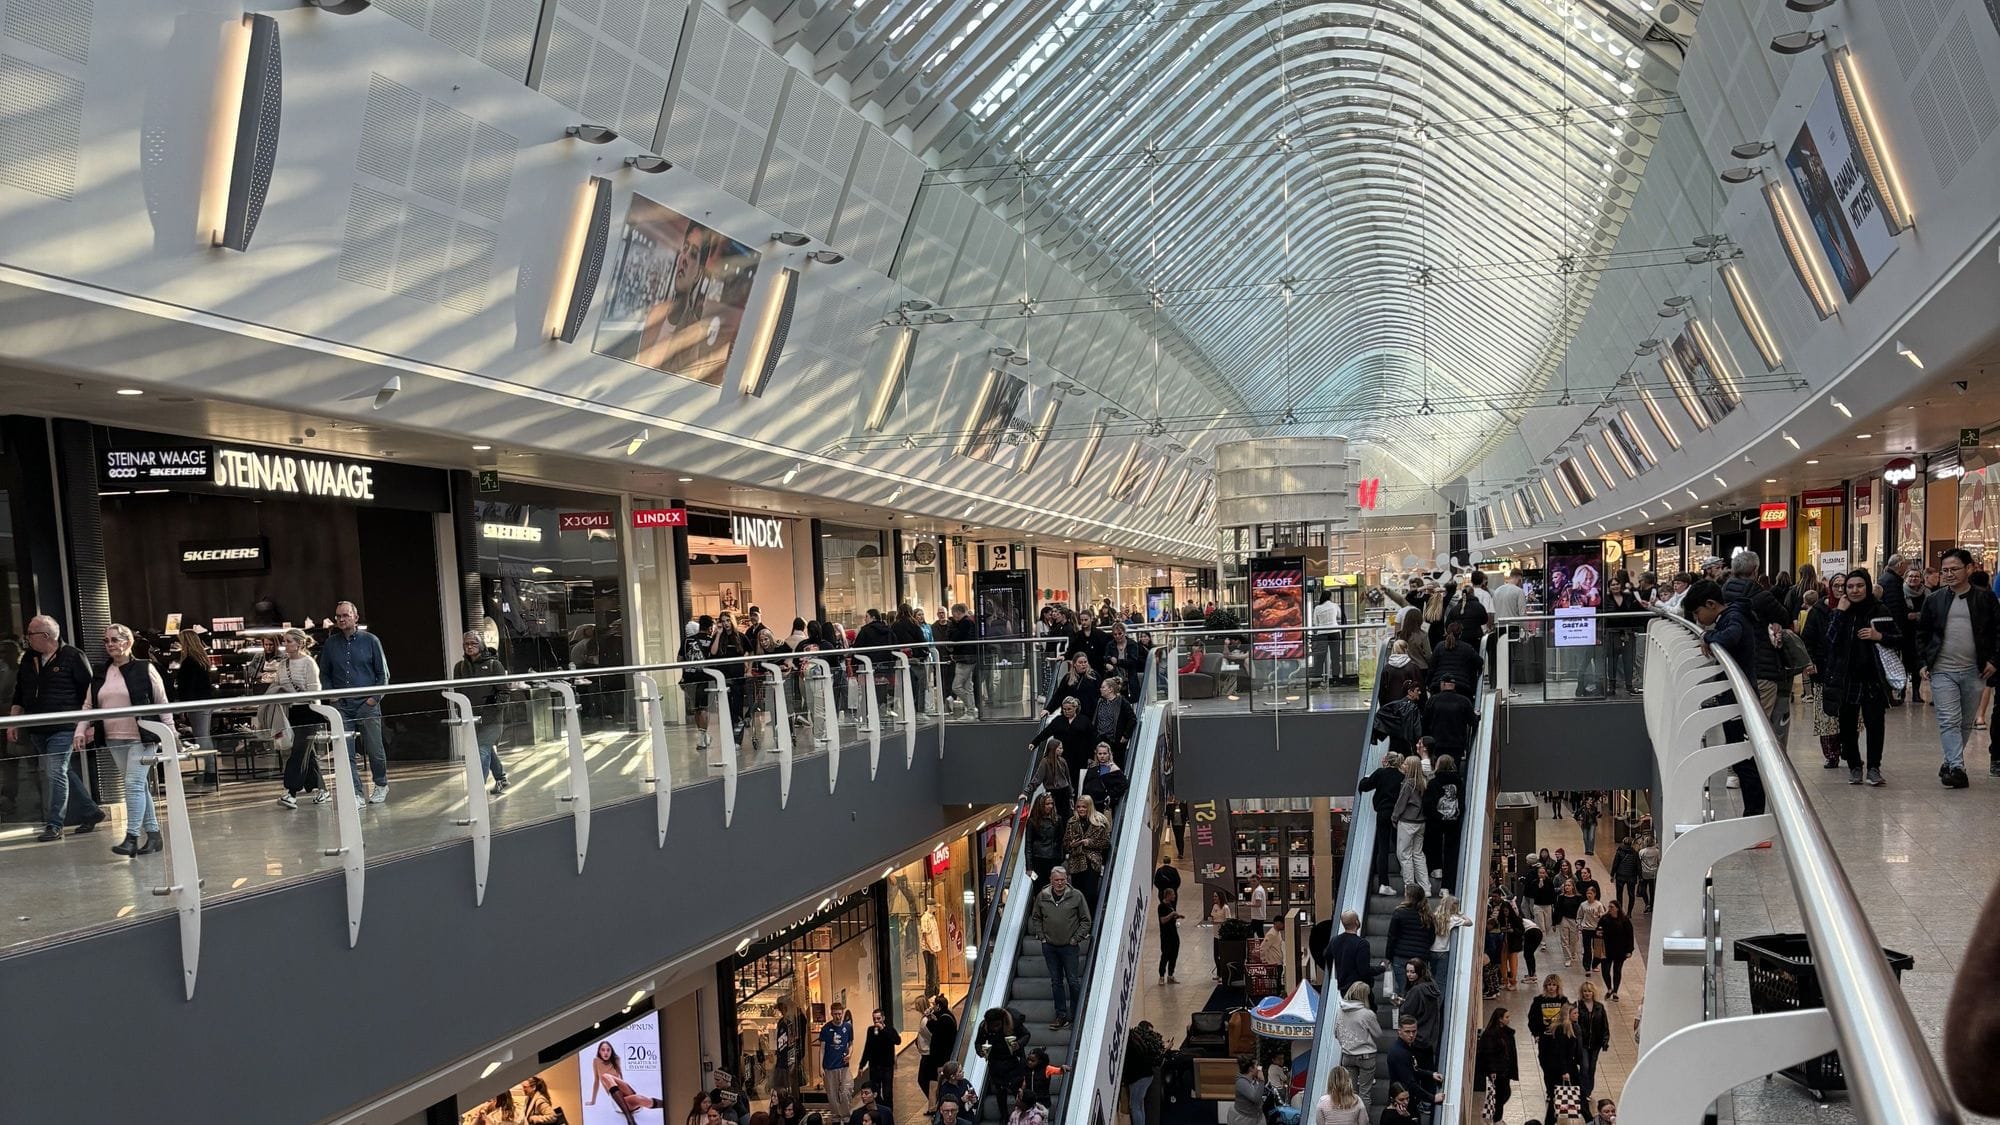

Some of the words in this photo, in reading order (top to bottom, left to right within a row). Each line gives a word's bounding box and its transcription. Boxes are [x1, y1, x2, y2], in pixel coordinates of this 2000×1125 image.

[108, 452, 156, 466] STEINAR
[159, 450, 207, 465] WAAGE
[149, 467, 207, 477] SKECHERS
[301, 459, 374, 499] WAAGE
[637, 512, 681, 524] LINDEX
[1761, 510, 1786, 521] LEGO
[733, 515, 784, 549] LINDEX
[183, 547, 259, 561] SKECHERS
[1256, 1021, 1316, 1036] GALLOPE
[628, 1046, 657, 1060] 20%
